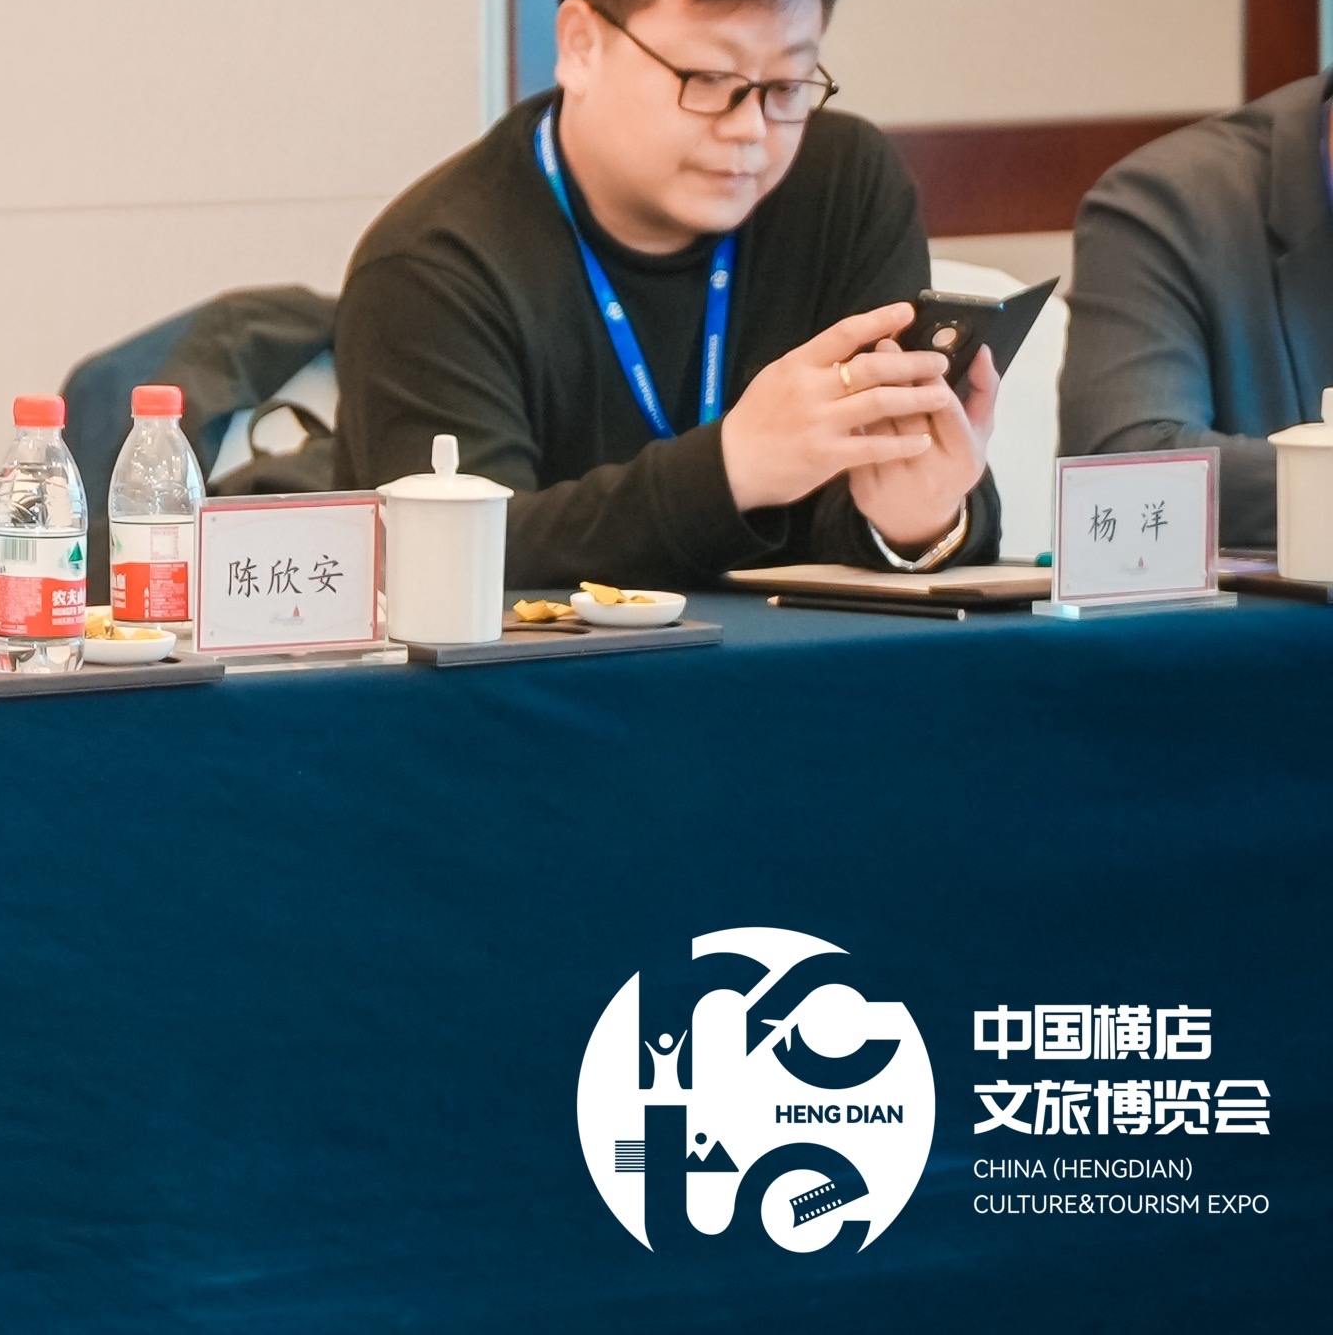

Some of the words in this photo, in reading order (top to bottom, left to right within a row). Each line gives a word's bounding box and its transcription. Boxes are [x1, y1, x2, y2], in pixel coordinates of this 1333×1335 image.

[1088, 500, 1168, 543] 杨洋
[228, 554, 343, 598] 陈欣安
